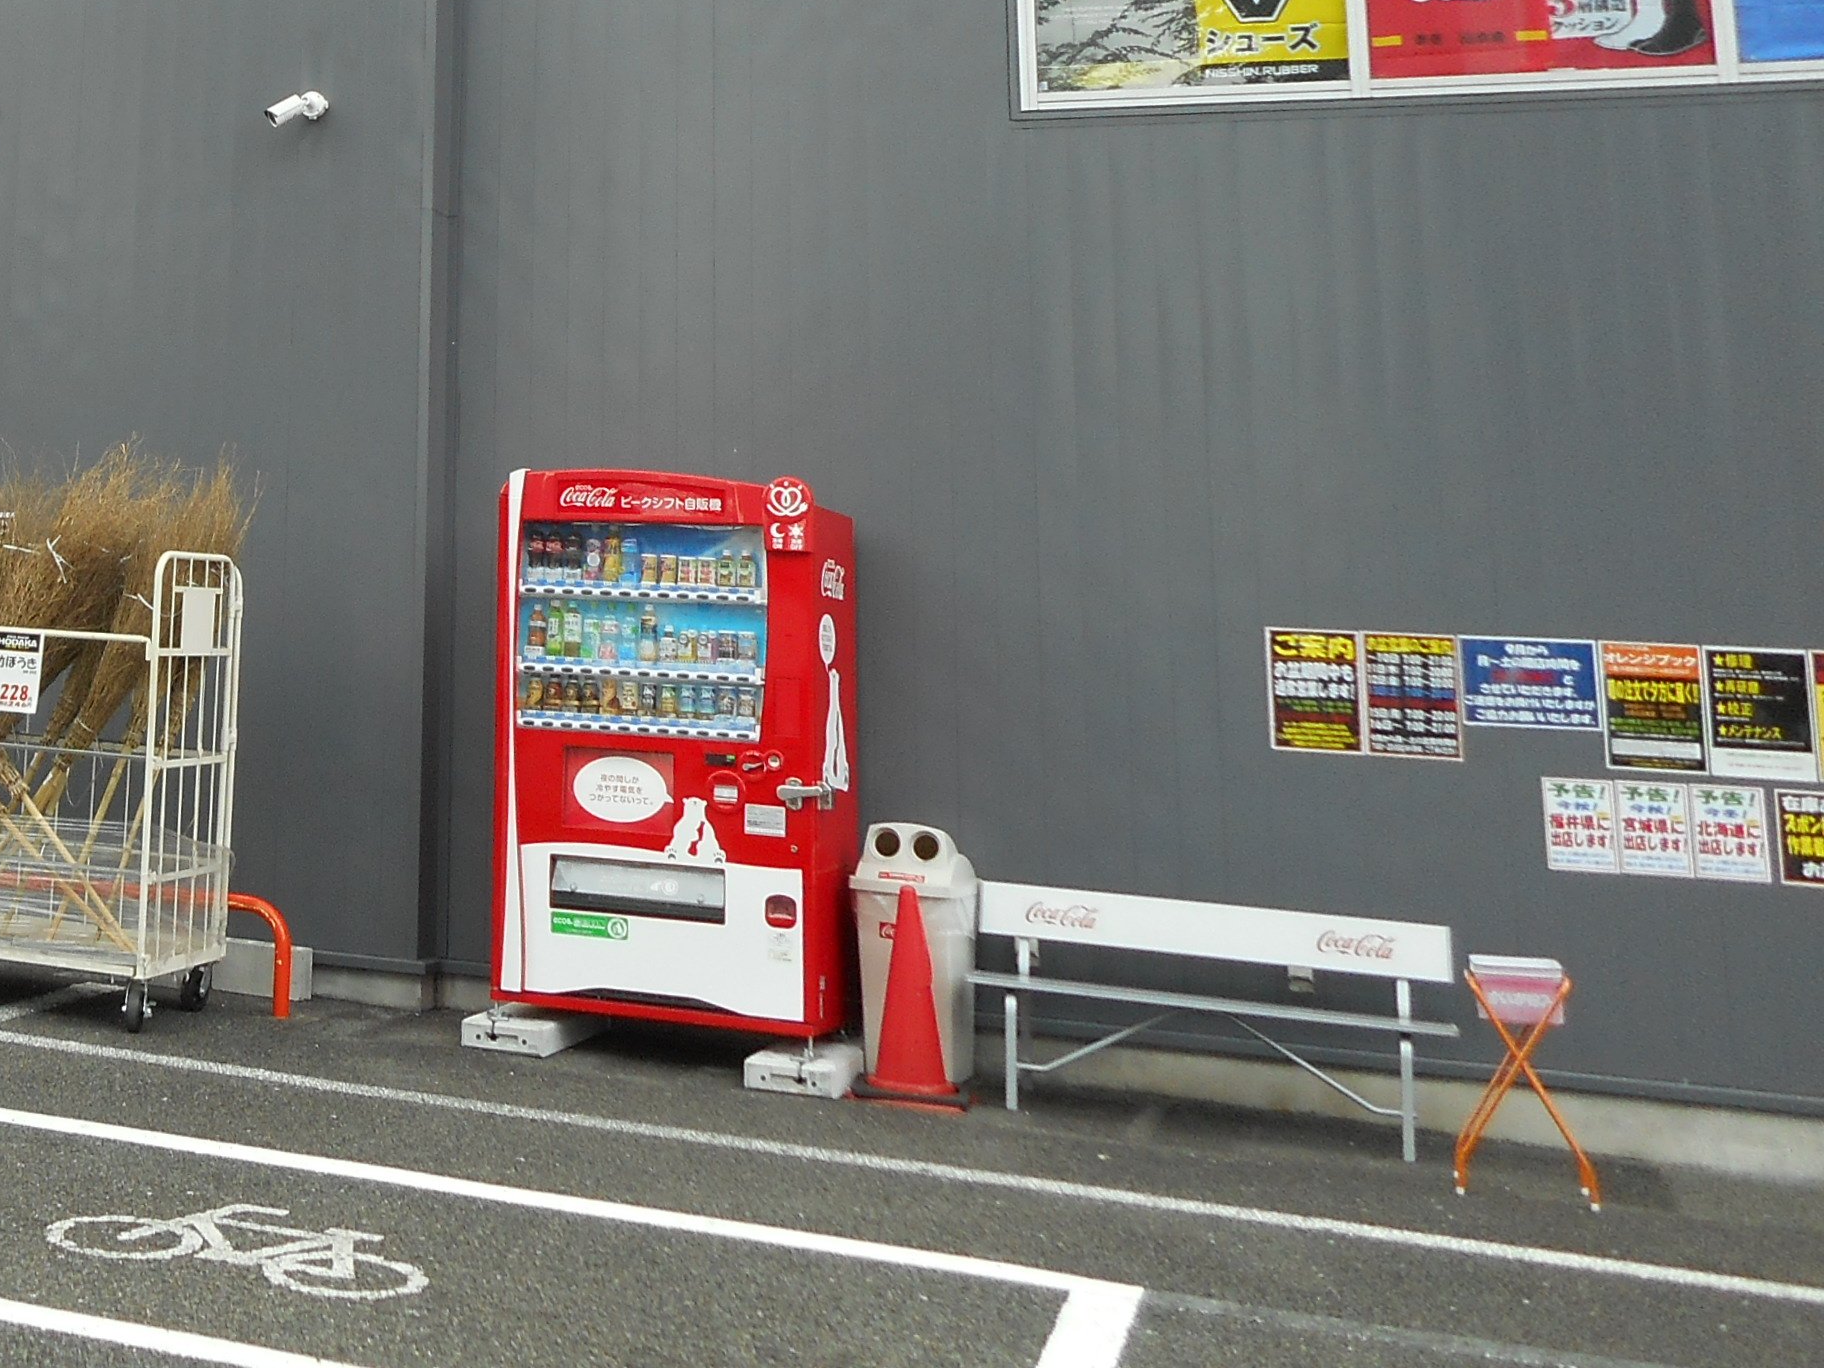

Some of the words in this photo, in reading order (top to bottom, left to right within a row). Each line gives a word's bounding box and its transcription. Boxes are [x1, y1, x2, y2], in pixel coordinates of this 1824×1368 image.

[1551, 16, 1619, 34] クッション
[1207, 22, 1319, 56] シューズ
[1262, 64, 1319, 77] RUBBER
[1274, 635, 1356, 661] ご案内
[1603, 651, 1697, 667] オレンジブック
[0, 684, 29, 701] 228
[1727, 727, 1782, 739] メンテナンス
[1548, 782, 1606, 800] 予告!
[1622, 785, 1680, 803] 予告!
[1698, 789, 1755, 806] 予告!
[1549, 813, 1611, 831] 福井県に
[1623, 817, 1685, 835] 宮城県に
[1697, 820, 1761, 838] 北海道に
[1025, 901, 1100, 931] Coca-Cola
[1316, 929, 1395, 960] Coca-Cola
